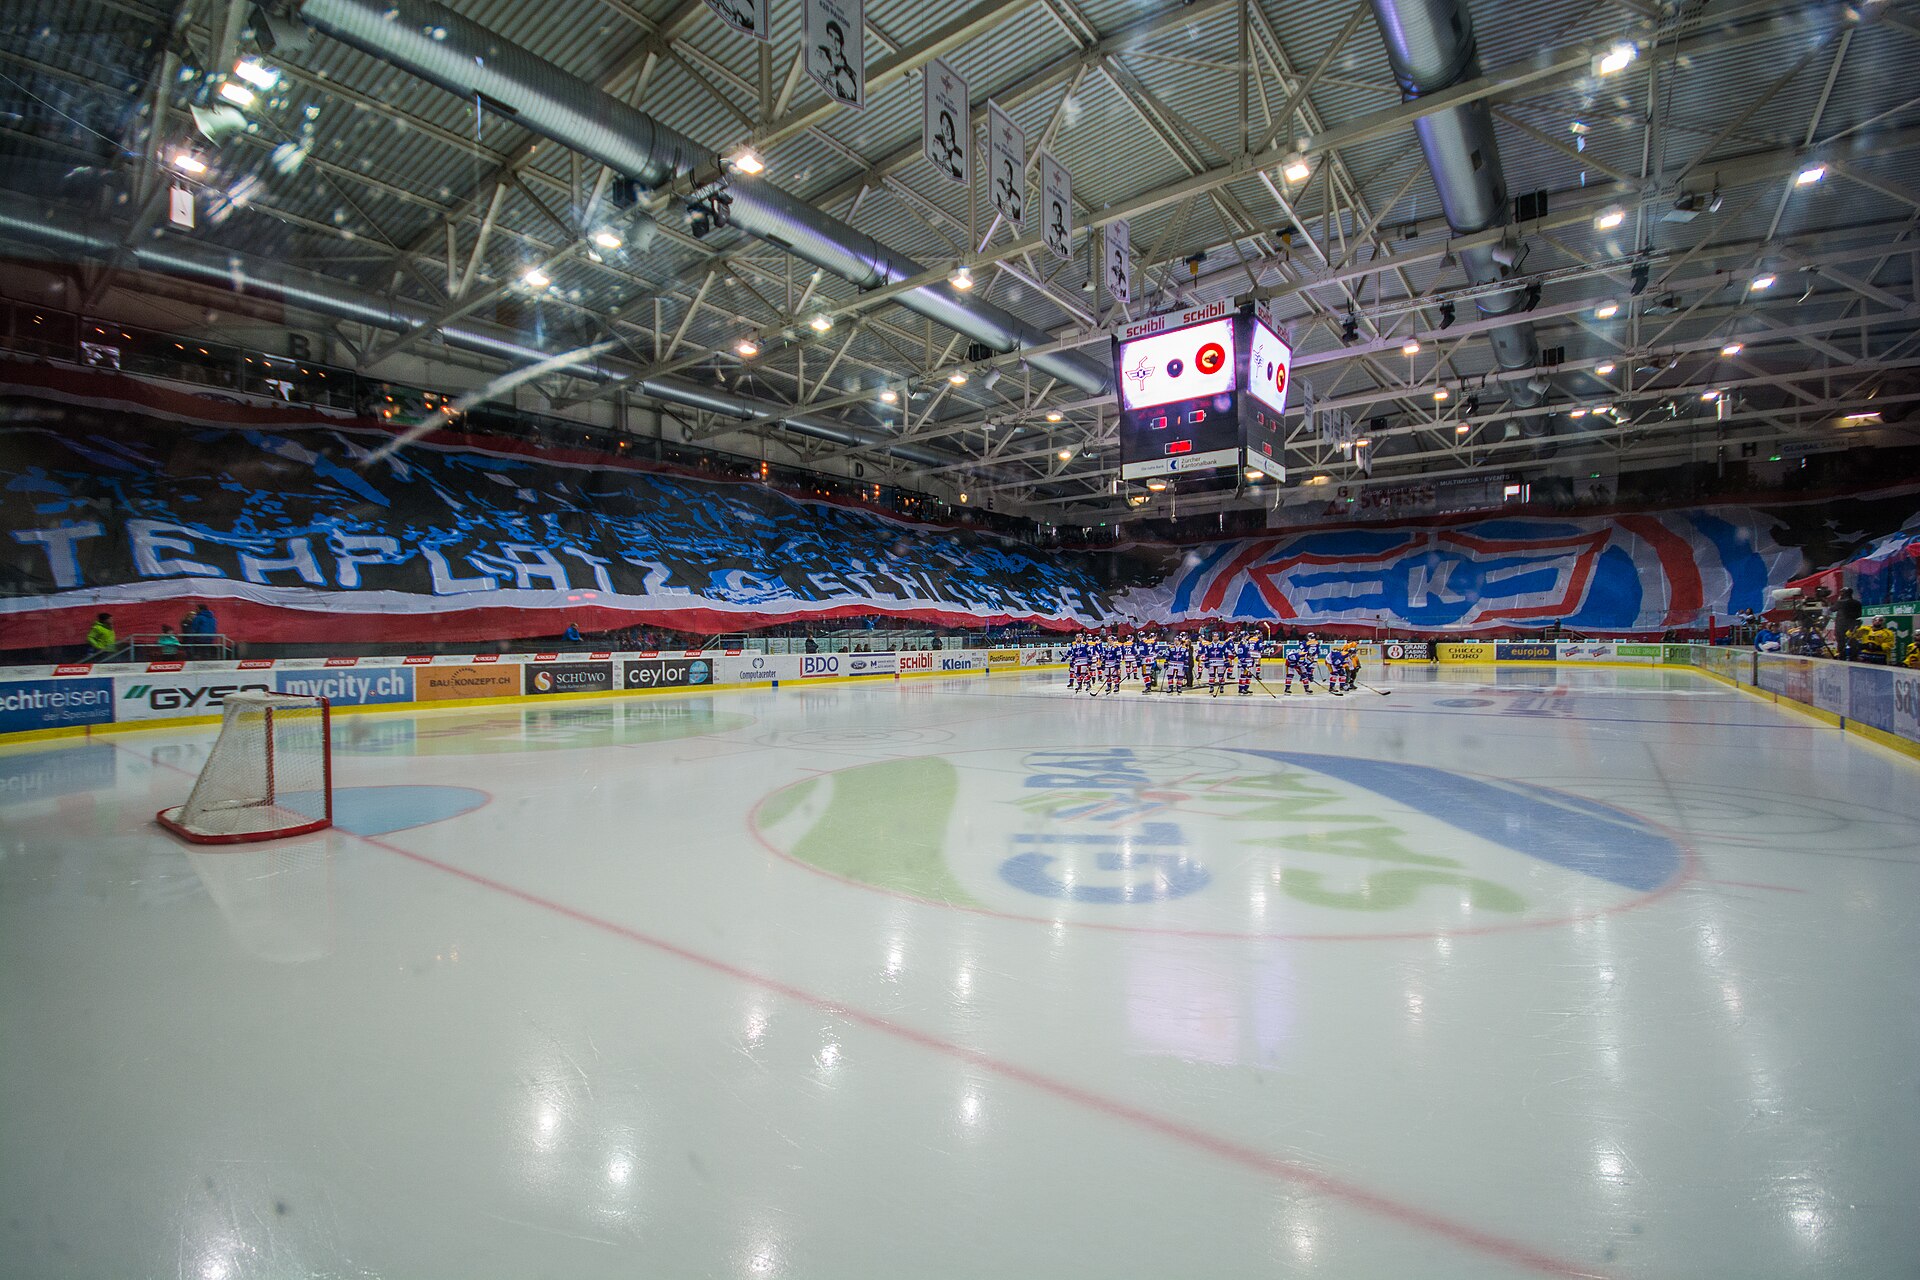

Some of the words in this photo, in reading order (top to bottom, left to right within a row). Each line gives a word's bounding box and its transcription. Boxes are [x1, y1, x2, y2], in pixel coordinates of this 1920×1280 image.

[1440, 476, 1479, 486] MULTIMEDIA
[1484, 474, 1510, 482] EVENTS
[1511, 646, 1550, 657] eurojob
[805, 656, 839, 673] BDO
[942, 658, 972, 670] Klein
[556, 671, 606, 684] SCHÜWO
[629, 661, 686, 688] ceylor
[739, 669, 777, 681] Computacenter
